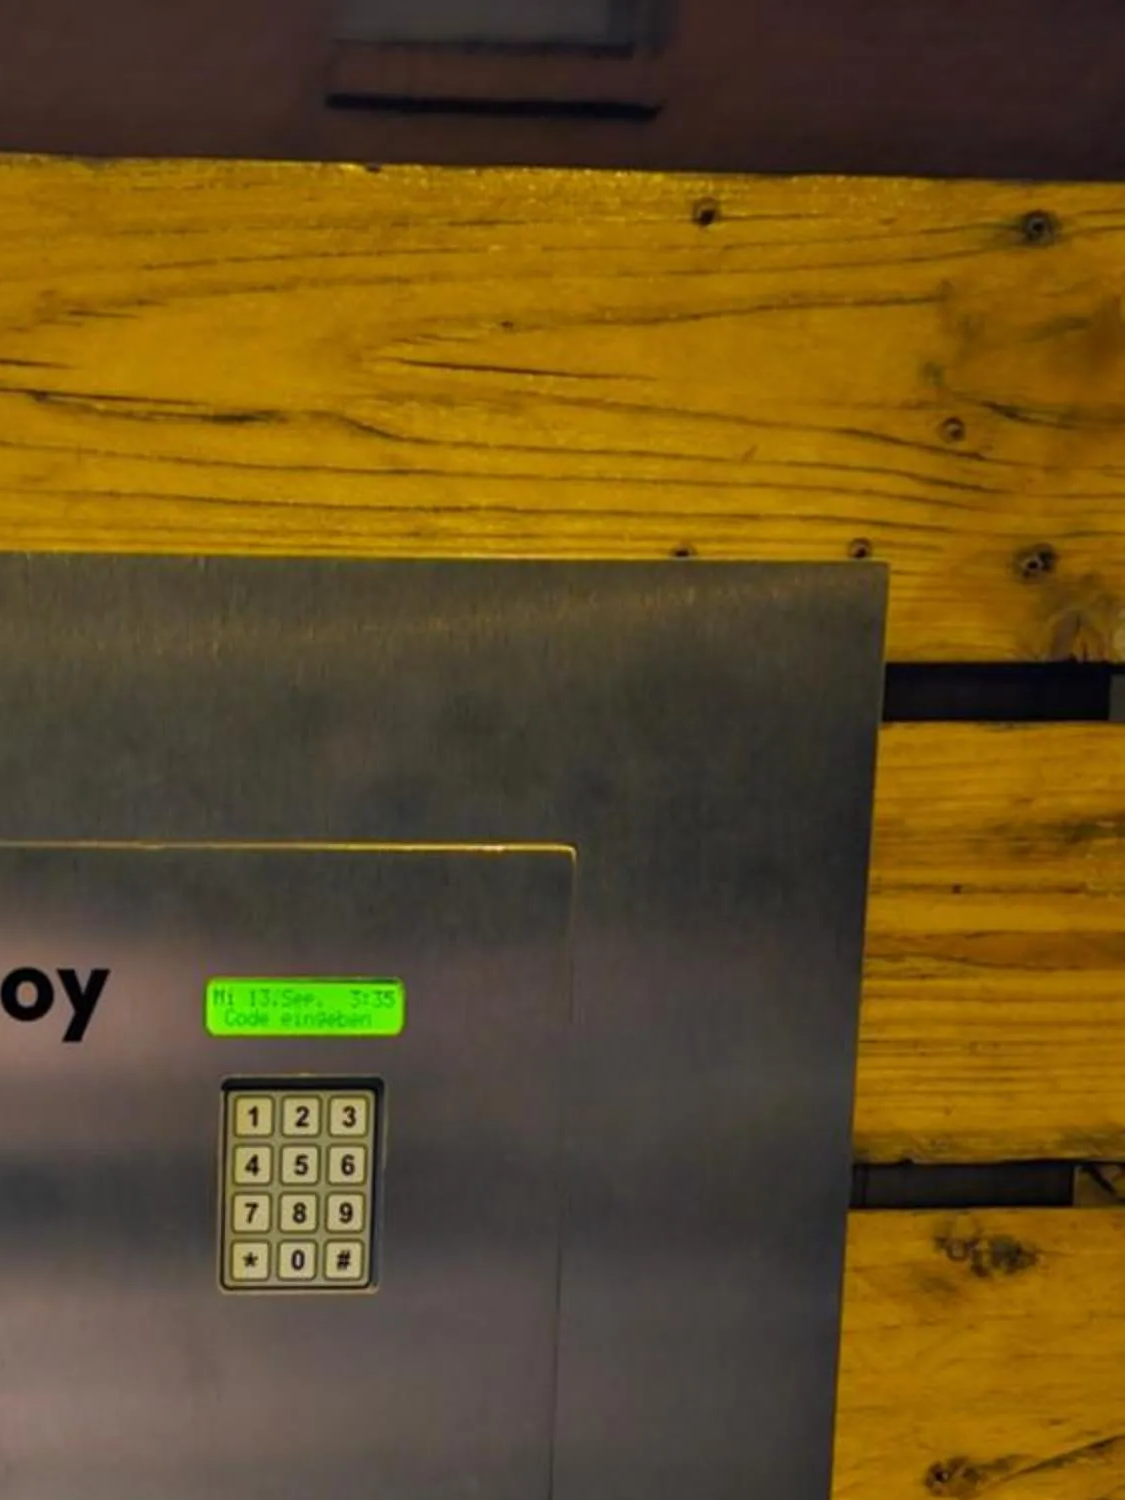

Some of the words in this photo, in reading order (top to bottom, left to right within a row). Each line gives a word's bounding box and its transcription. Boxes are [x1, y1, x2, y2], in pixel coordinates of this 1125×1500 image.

[224, 1009, 269, 1027] Code
[248, 1106, 259, 1128] 1
[295, 1106, 309, 1128] 2
[342, 1106, 356, 1128] 3
[245, 1154, 260, 1176] 4
[294, 1154, 309, 1176] 5
[341, 1154, 356, 1176] 6
[244, 1202, 259, 1224] 7
[292, 1202, 307, 1224] 8
[339, 1202, 353, 1224] 9
[291, 1250, 305, 1270] 0
[336, 1250, 352, 1270] #
